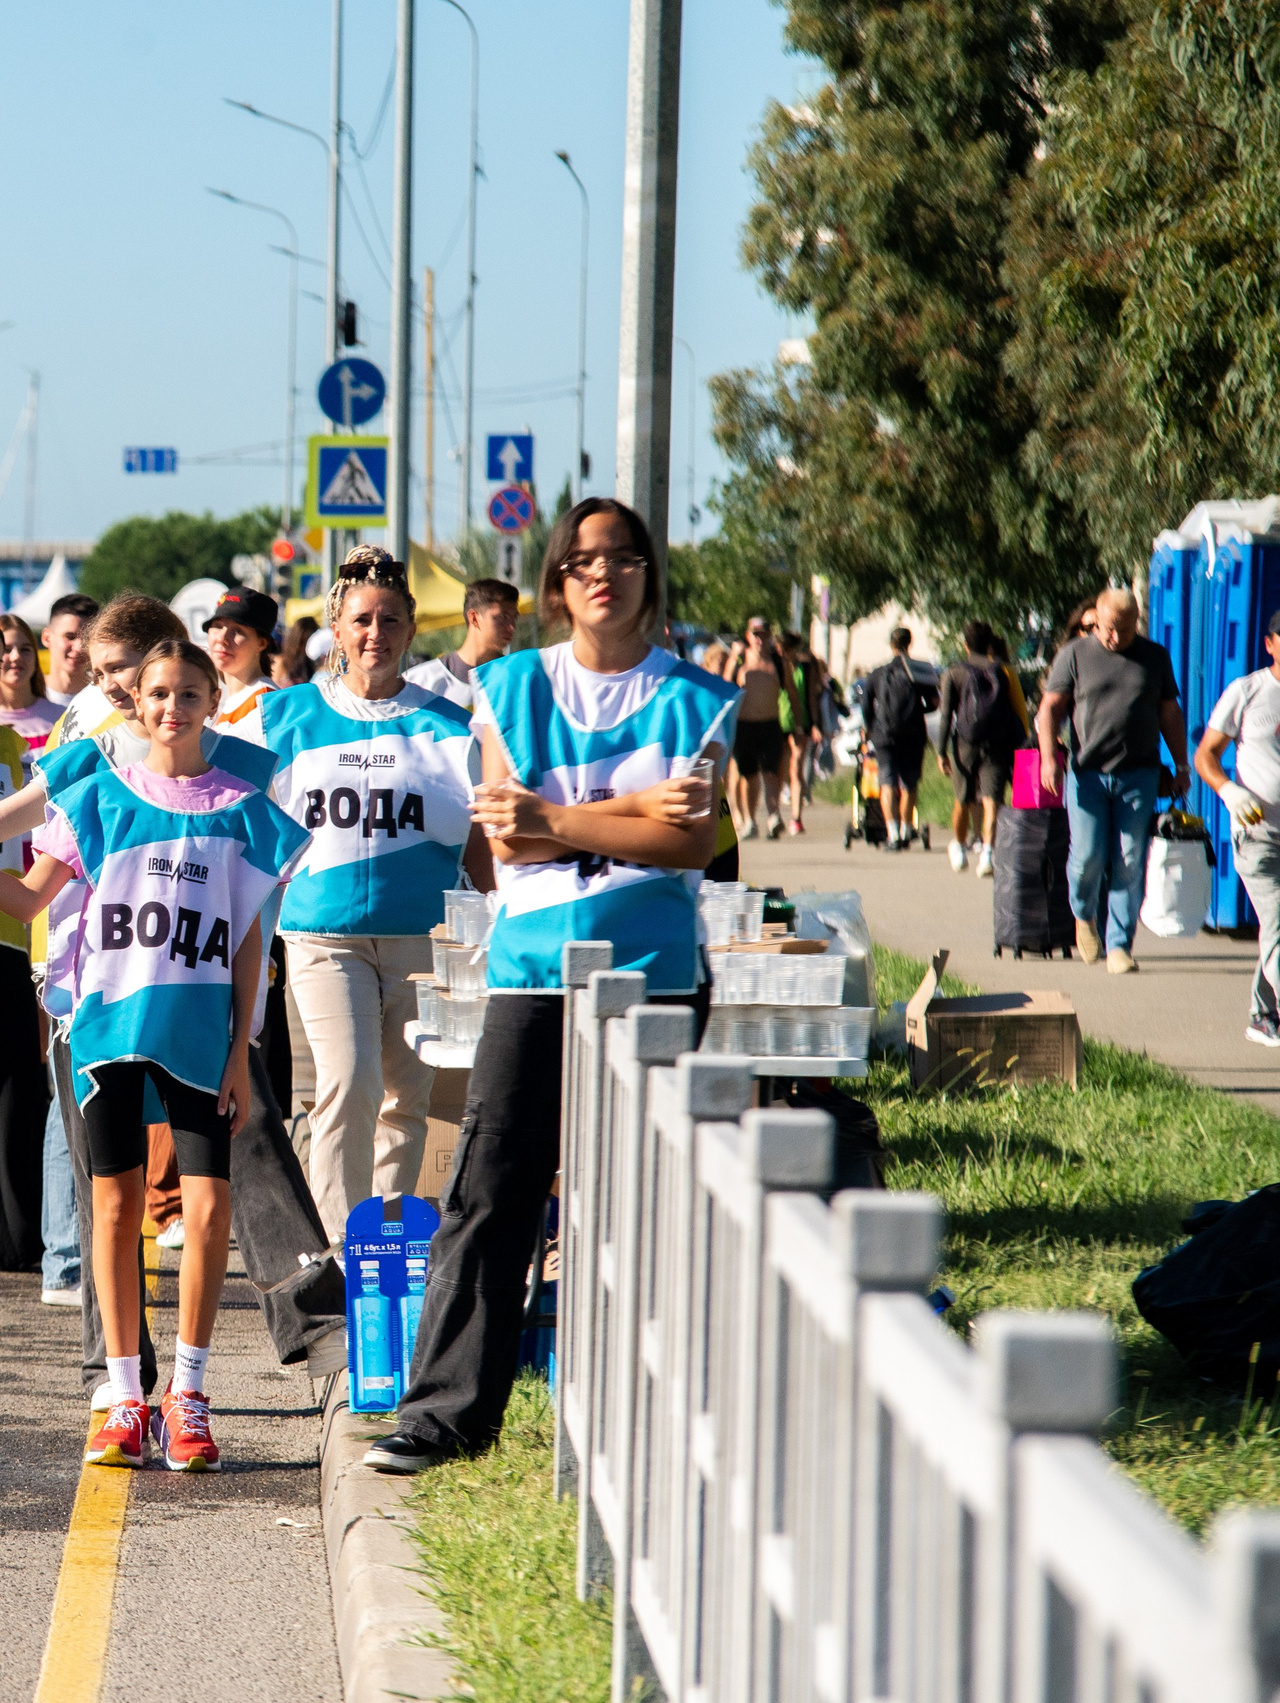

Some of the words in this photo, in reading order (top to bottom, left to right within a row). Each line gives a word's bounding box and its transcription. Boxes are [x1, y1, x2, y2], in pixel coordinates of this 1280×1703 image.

[339, 753, 362, 764] IRON
[372, 754, 396, 764] STAR
[305, 787, 425, 838] ВОДА
[148, 857, 173, 873] IRON
[183, 861, 209, 880] STAR
[101, 901, 230, 970] ВОДА
